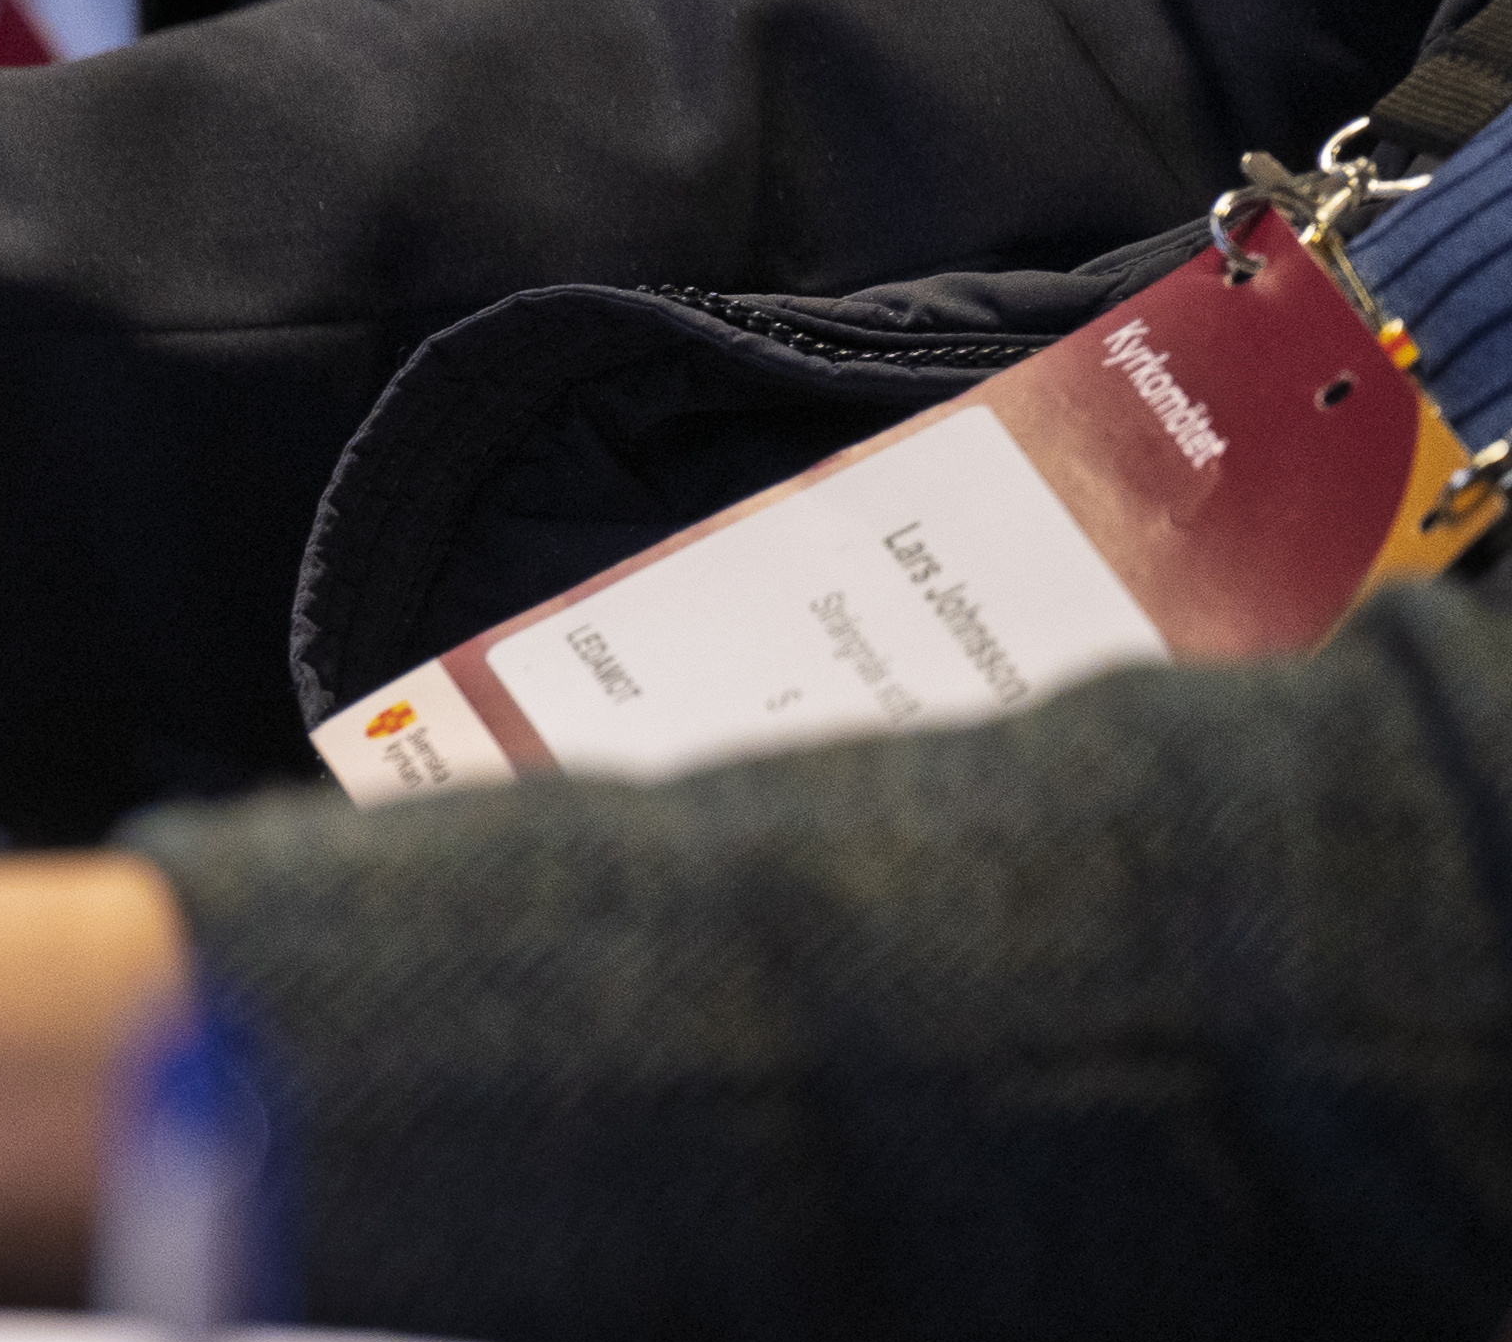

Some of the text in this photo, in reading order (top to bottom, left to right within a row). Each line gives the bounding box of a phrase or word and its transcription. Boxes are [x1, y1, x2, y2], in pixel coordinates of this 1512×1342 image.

[1101, 318, 1230, 470] Kyrkomötet
[883, 520, 942, 583] Lars
[566, 623, 642, 704] LEDAMOT
